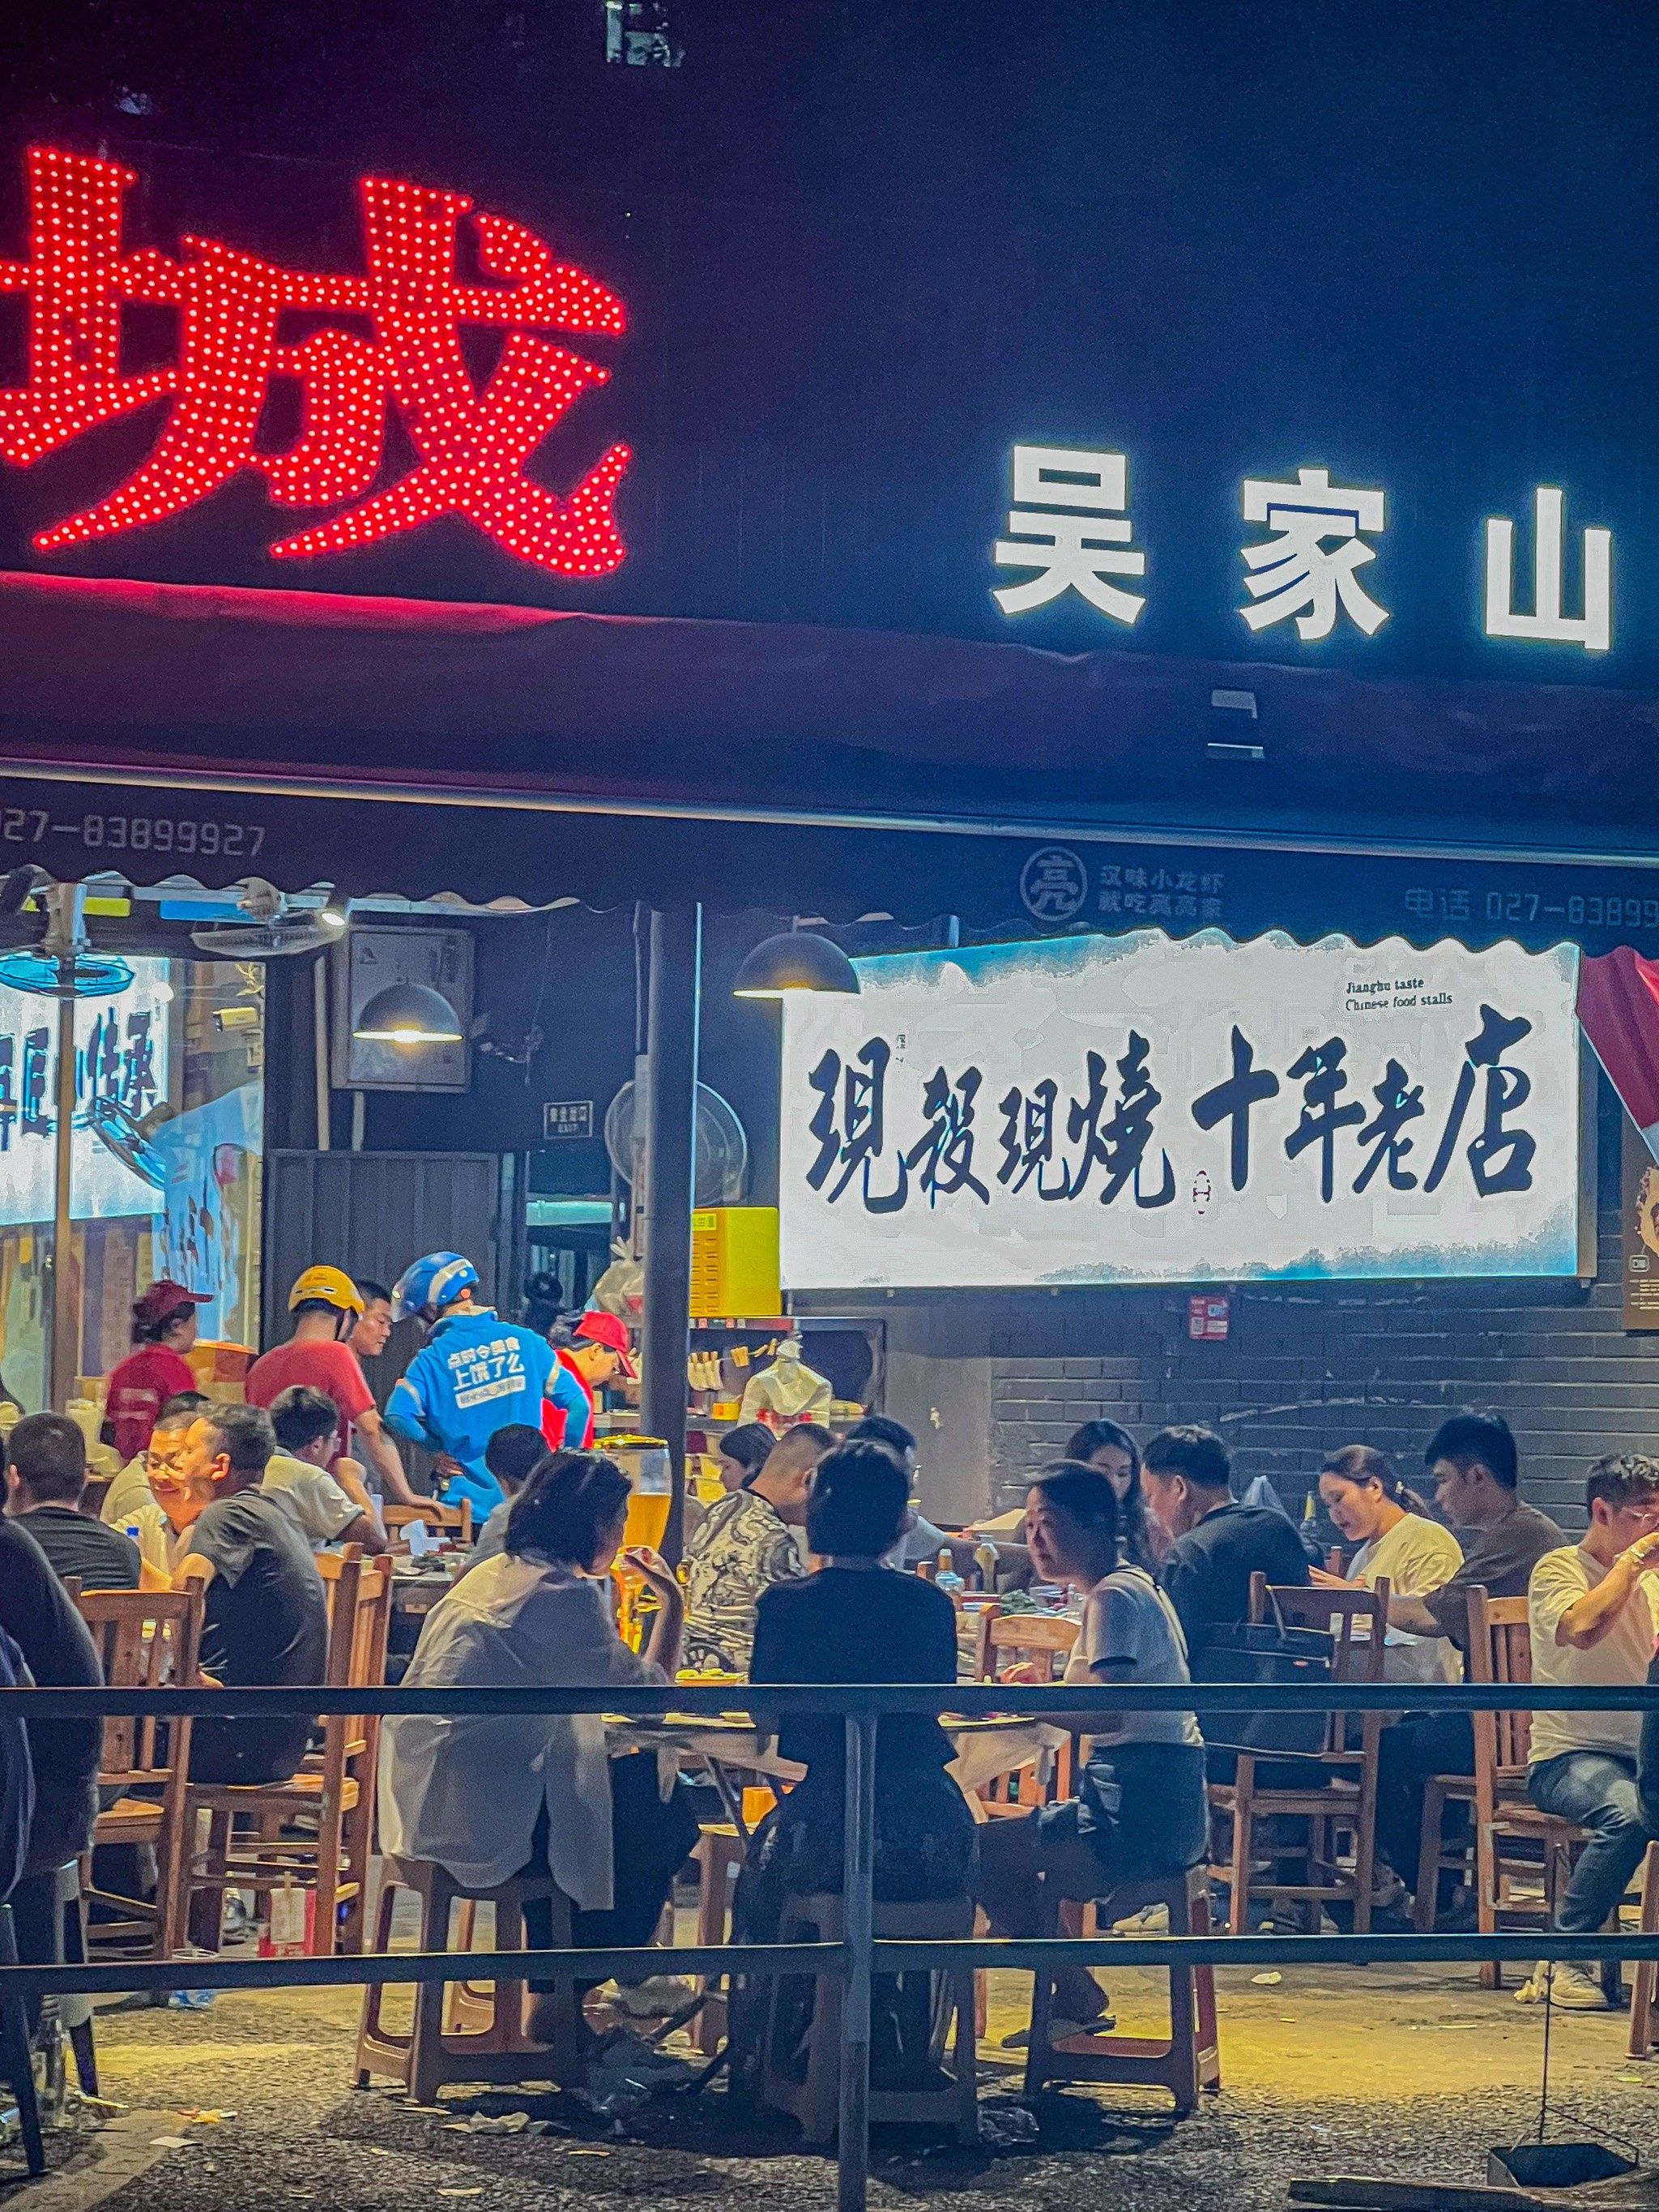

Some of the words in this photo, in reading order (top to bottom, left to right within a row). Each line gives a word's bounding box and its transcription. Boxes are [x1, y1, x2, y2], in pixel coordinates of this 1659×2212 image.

[0, 147, 634, 579] 城
[992, 445, 1613, 651] 吴家山
[0, 808, 266, 856] 27-83899927
[1029, 853, 1081, 915] 亮
[1098, 865, 1225, 894] 汉味小龙虾
[1404, 888, 1470, 920] 电话
[1346, 980, 1391, 996] Jianghu
[1395, 978, 1424, 990] taste
[1346, 998, 1389, 1011] Chinese
[1393, 995, 1417, 1008] food
[1420, 992, 1453, 1006] stalls
